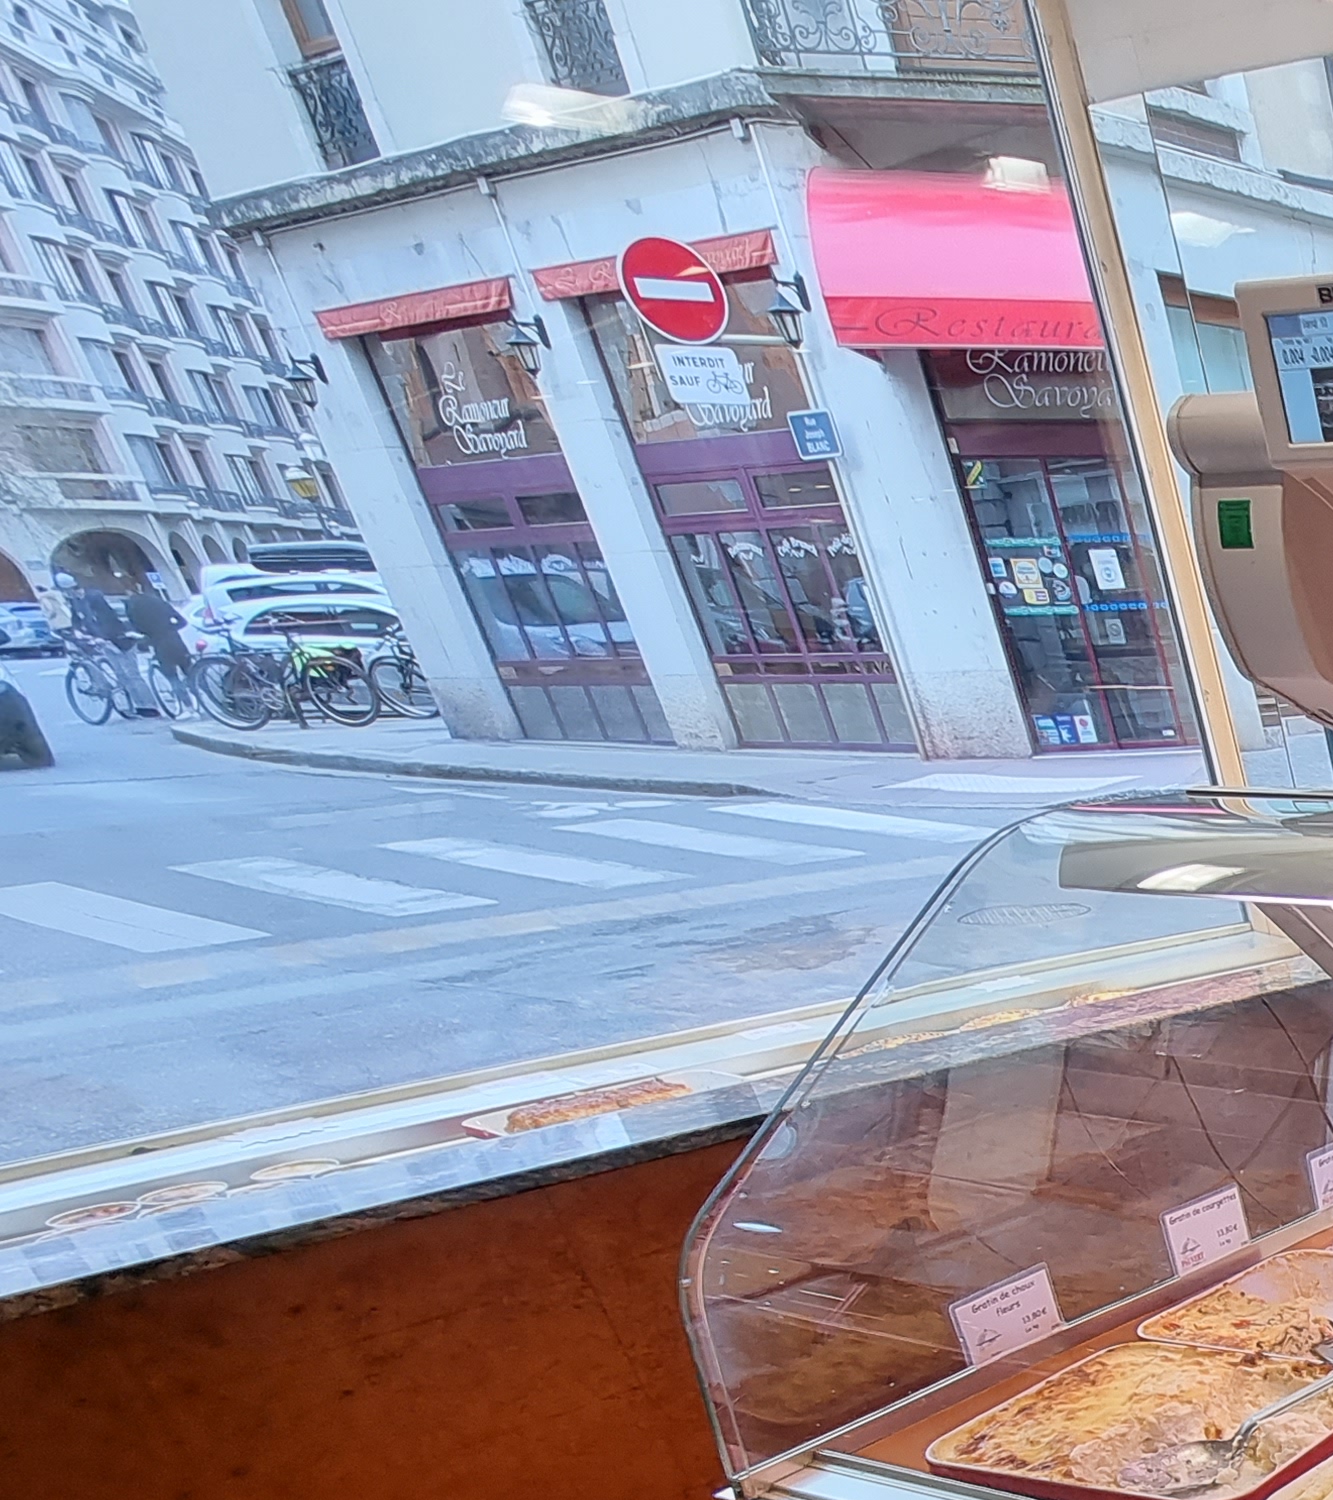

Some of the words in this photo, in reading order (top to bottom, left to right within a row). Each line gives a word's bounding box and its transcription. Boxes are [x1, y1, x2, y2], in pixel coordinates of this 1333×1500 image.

[671, 355, 726, 369] INTERDIT
[669, 374, 701, 387] SAUF
[1168, 1211, 1191, 1225] Gratin
[1192, 1208, 1201, 1216] de
[1201, 1193, 1237, 1212] courgettes
[971, 1296, 999, 1314] Gratin
[999, 1291, 1010, 1301] de
[1011, 1280, 1035, 1295] choux
